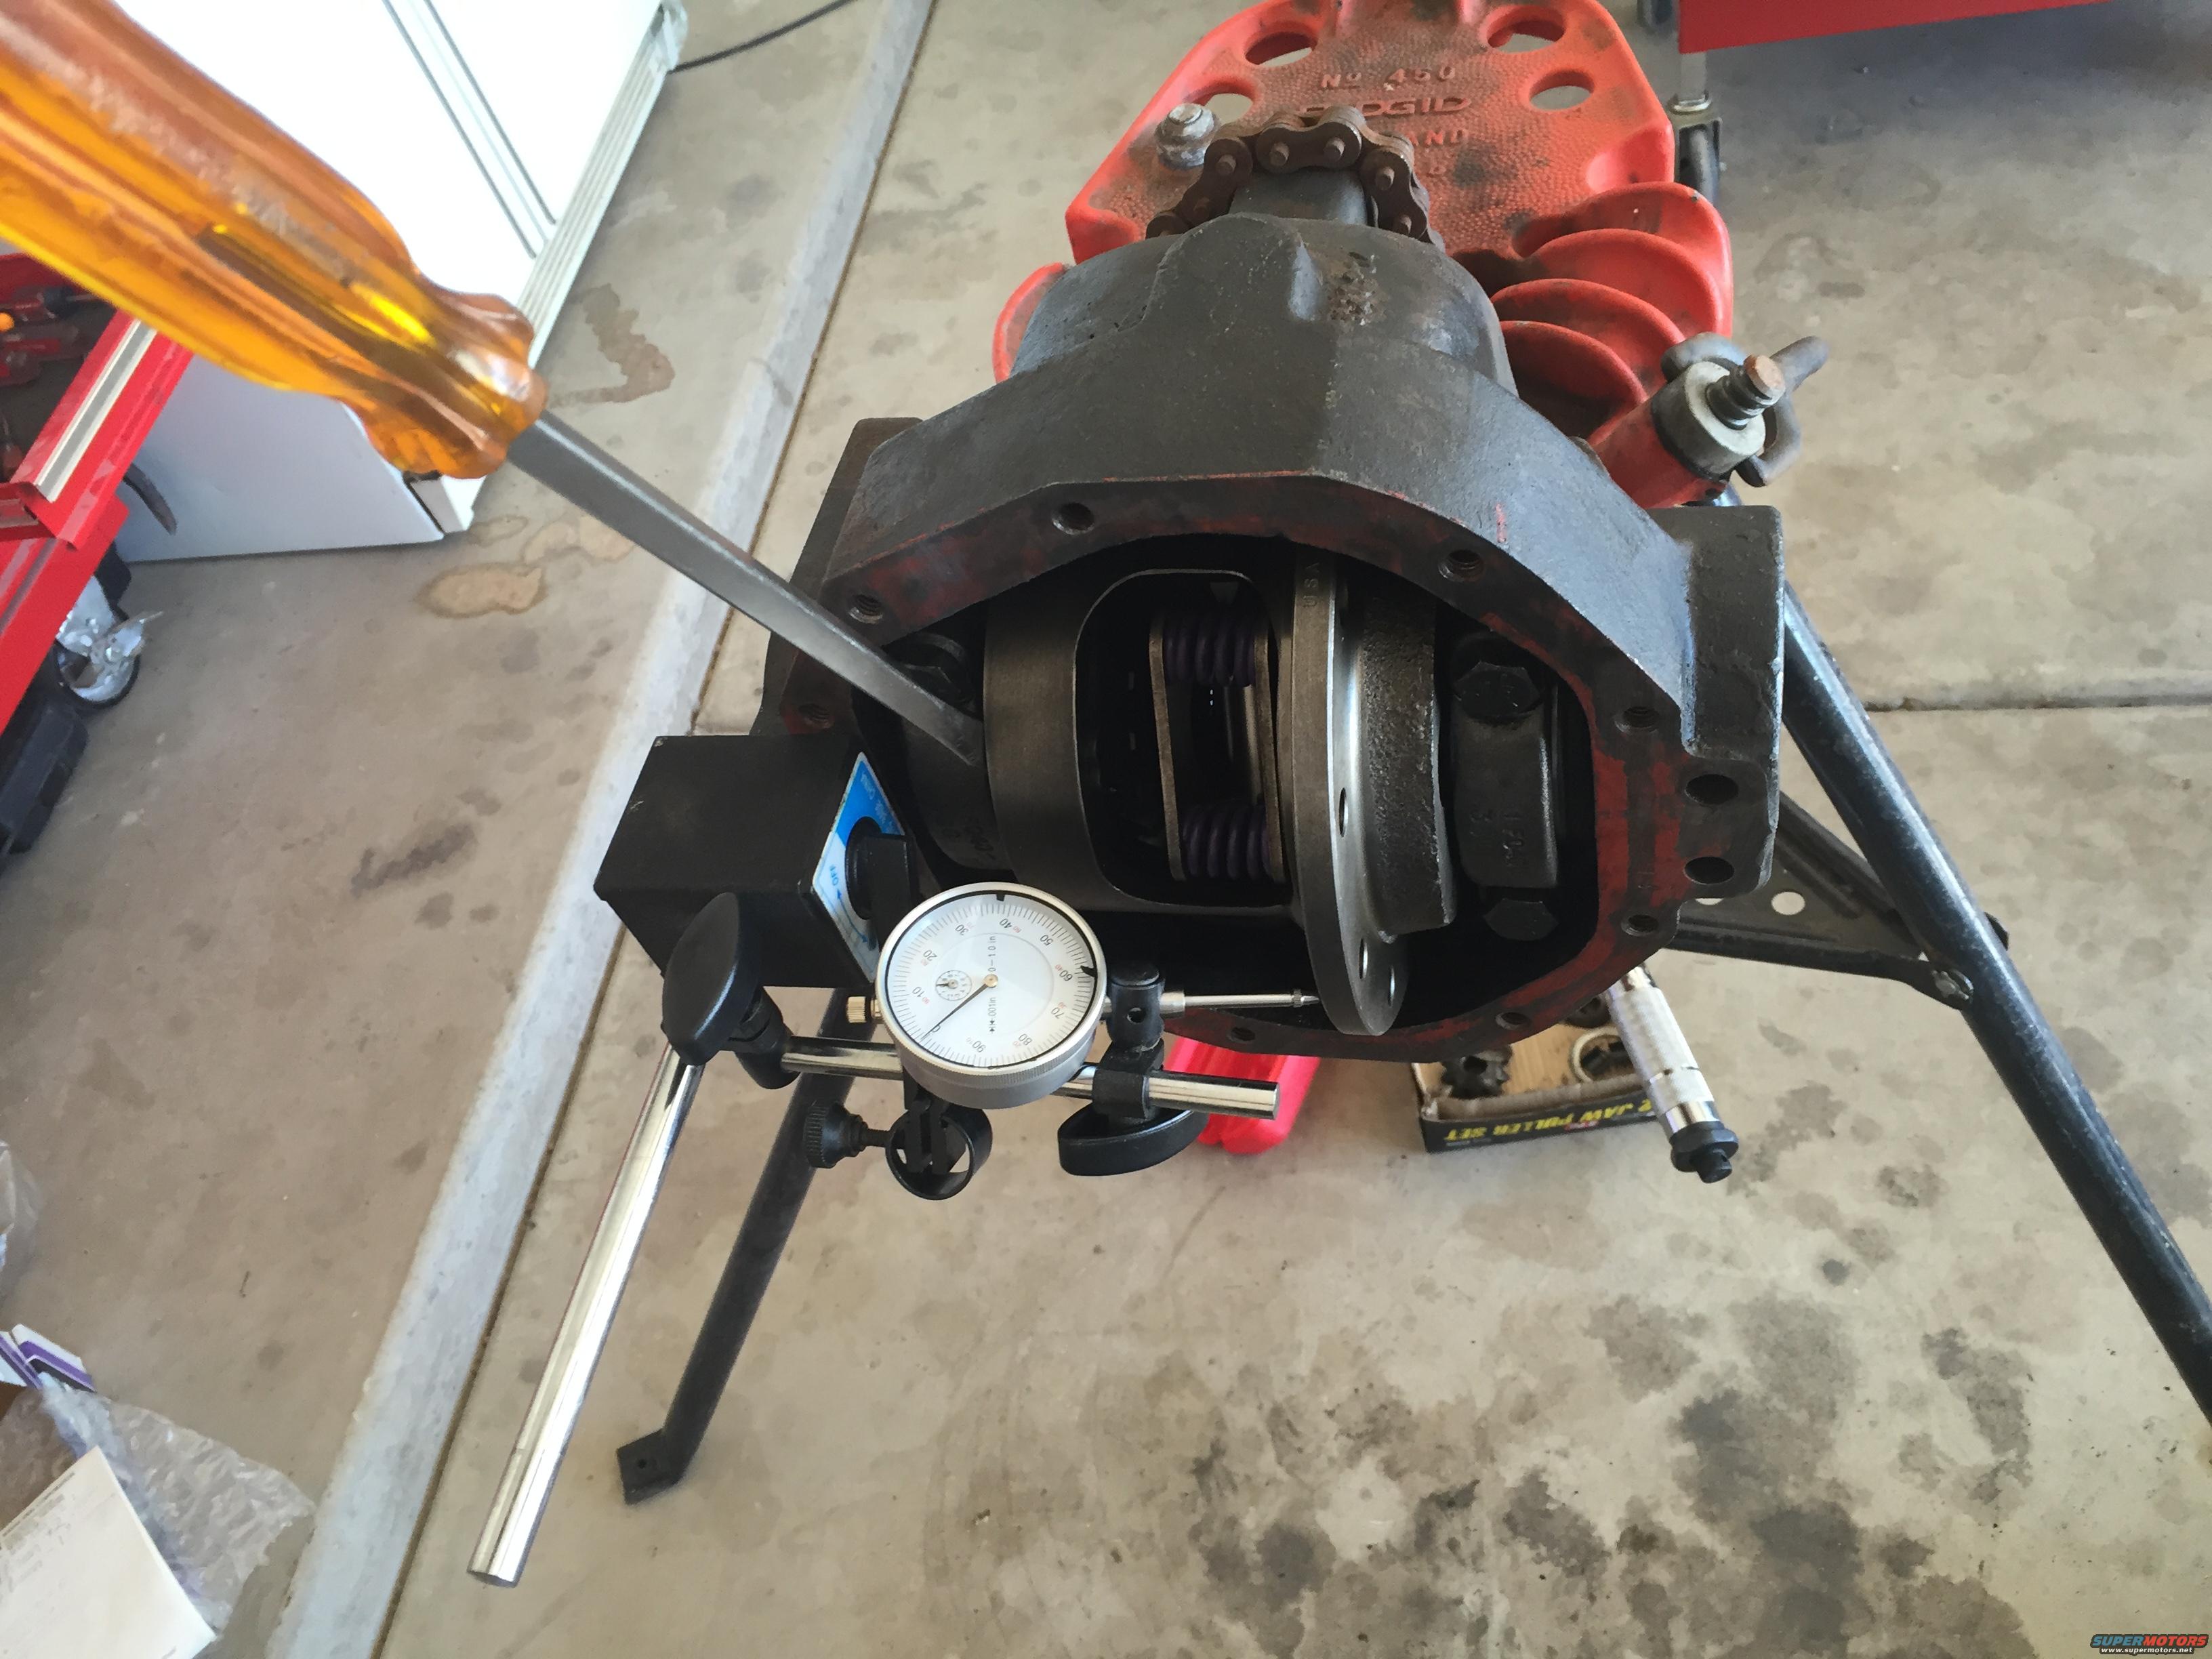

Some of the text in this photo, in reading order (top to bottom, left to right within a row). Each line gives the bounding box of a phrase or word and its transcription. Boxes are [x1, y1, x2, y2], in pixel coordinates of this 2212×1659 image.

[1389, 64, 1456, 83] 450
[1302, 97, 1471, 117] DGID
[999, 918, 1012, 928] 40
[955, 924, 969, 936] 30
[1040, 935, 1054, 946] 50
[923, 949, 938, 961] 20
[1059, 970, 1073, 981] 60
[912, 986, 925, 998] 10
[1050, 1007, 1065, 1019] 70
[1018, 1033, 1033, 1046] 80
[972, 1040, 987, 1052] 90
[1580, 1103, 1634, 1123] JAW
[1493, 1113, 1575, 1136] PULLER
[1443, 1127, 1488, 1141] SET
